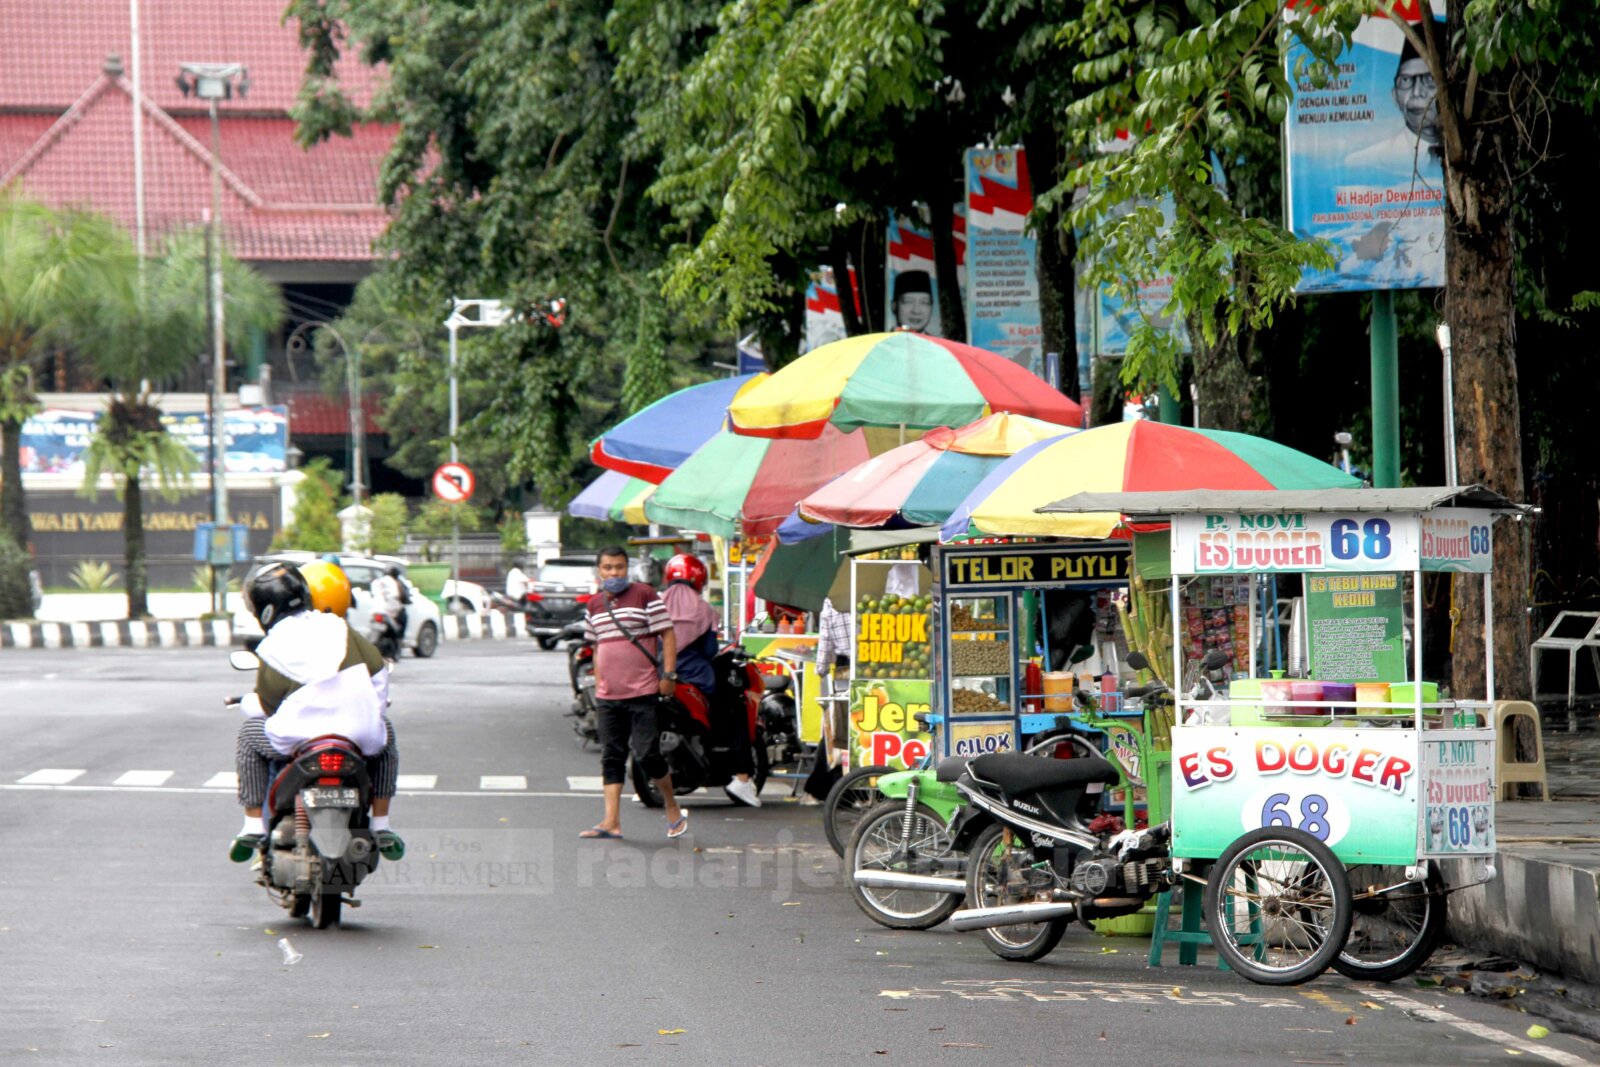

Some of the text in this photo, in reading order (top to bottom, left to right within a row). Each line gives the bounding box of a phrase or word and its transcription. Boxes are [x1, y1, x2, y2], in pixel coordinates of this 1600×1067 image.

[1332, 96, 1350, 106] ILMU
[1352, 94, 1368, 105] KITA
[1298, 112, 1328, 124] MENUJU
[1336, 189, 1442, 206] Ki Hadjar Dewantara
[1206, 514, 1307, 530] P. NOVI
[1200, 532, 1322, 566] ES DOGER
[1330, 518, 1392, 560] 68
[1422, 517, 1490, 559] ES DOGER 68
[952, 556, 1034, 583] TELOR
[1050, 555, 1117, 579] PUYU
[1311, 574, 1396, 591] ES TEBU HIJAU
[1333, 592, 1376, 608] KEDIRI
[858, 614, 929, 642] JERUK
[858, 642, 903, 663] BUAH
[873, 733, 931, 768] Pe
[956, 733, 1010, 756] CILOK
[1440, 740, 1476, 764] P. NOVI
[1179, 746, 1234, 788] ES
[1254, 739, 1412, 792] DOGER
[1428, 768, 1488, 804] ES DOGER
[1260, 792, 1331, 843] 68
[1448, 806, 1470, 846] 68
